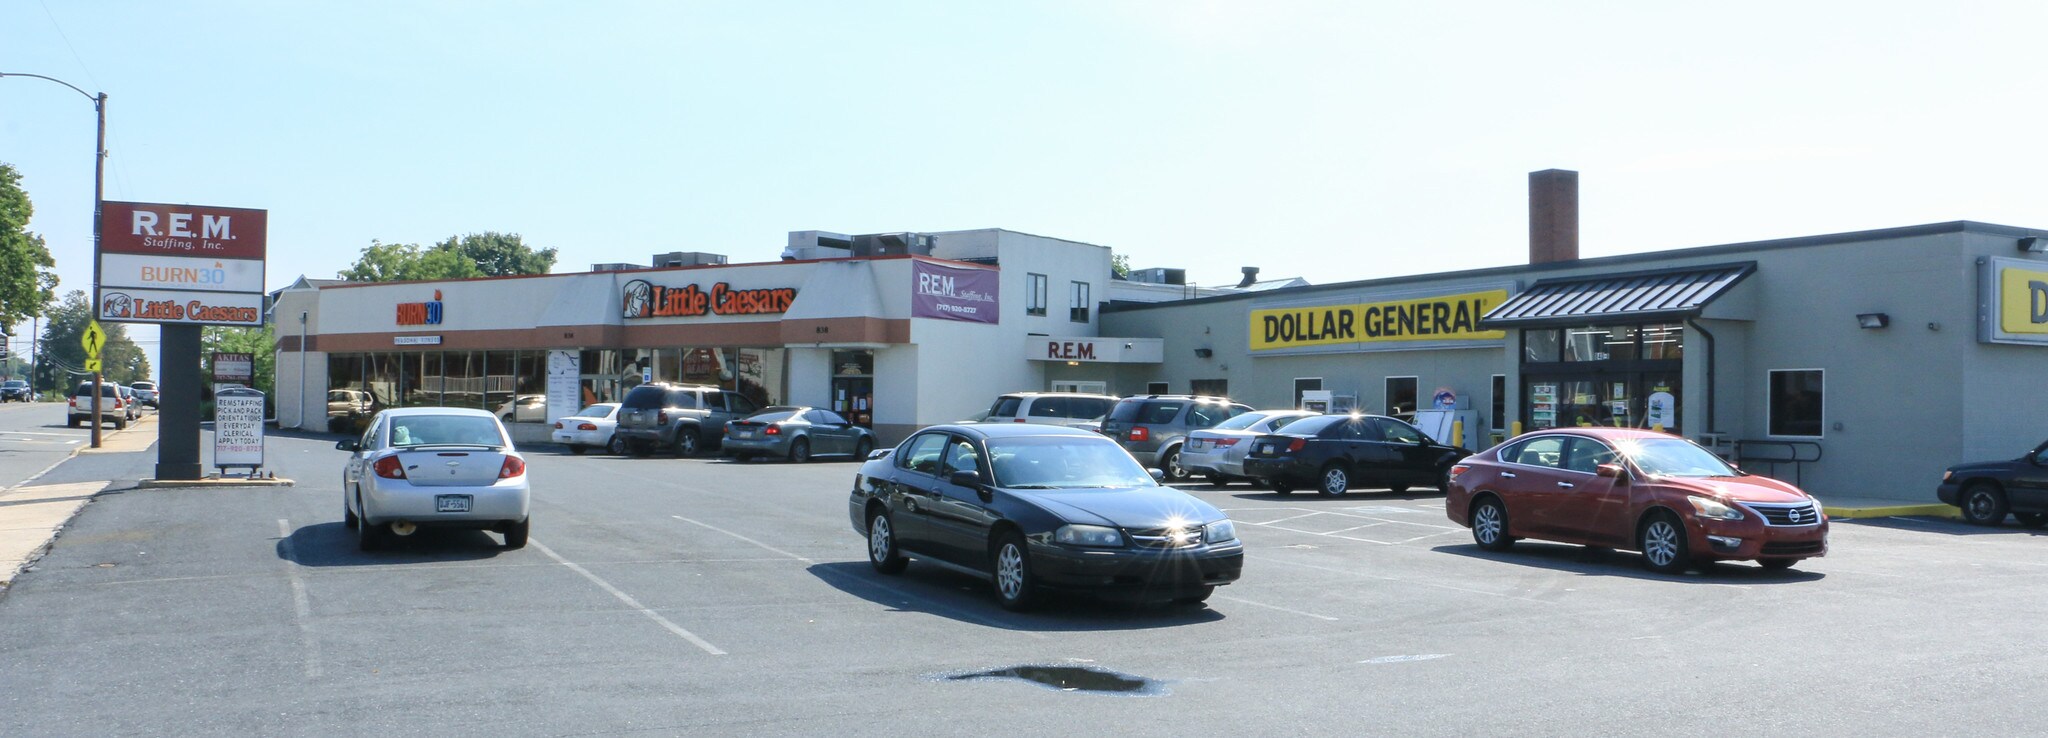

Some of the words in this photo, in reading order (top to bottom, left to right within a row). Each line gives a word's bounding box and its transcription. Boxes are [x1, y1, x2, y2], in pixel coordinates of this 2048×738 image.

[132, 210, 236, 240] R.E.M.
[143, 236, 195, 250] Staffing,
[202, 240, 225, 250] Inc.
[141, 266, 225, 284] BURN30
[919, 272, 955, 296] R.E.M.
[133, 298, 184, 320] Little
[186, 300, 257, 323] Caesars
[652, 284, 708, 316] Little
[711, 282, 796, 316] Caesars
[396, 302, 443, 326] BURN30
[1263, 309, 1355, 343] DOLLAR
[1364, 299, 1487, 338] GENERAL
[1048, 341, 1096, 360] R.E.M.
